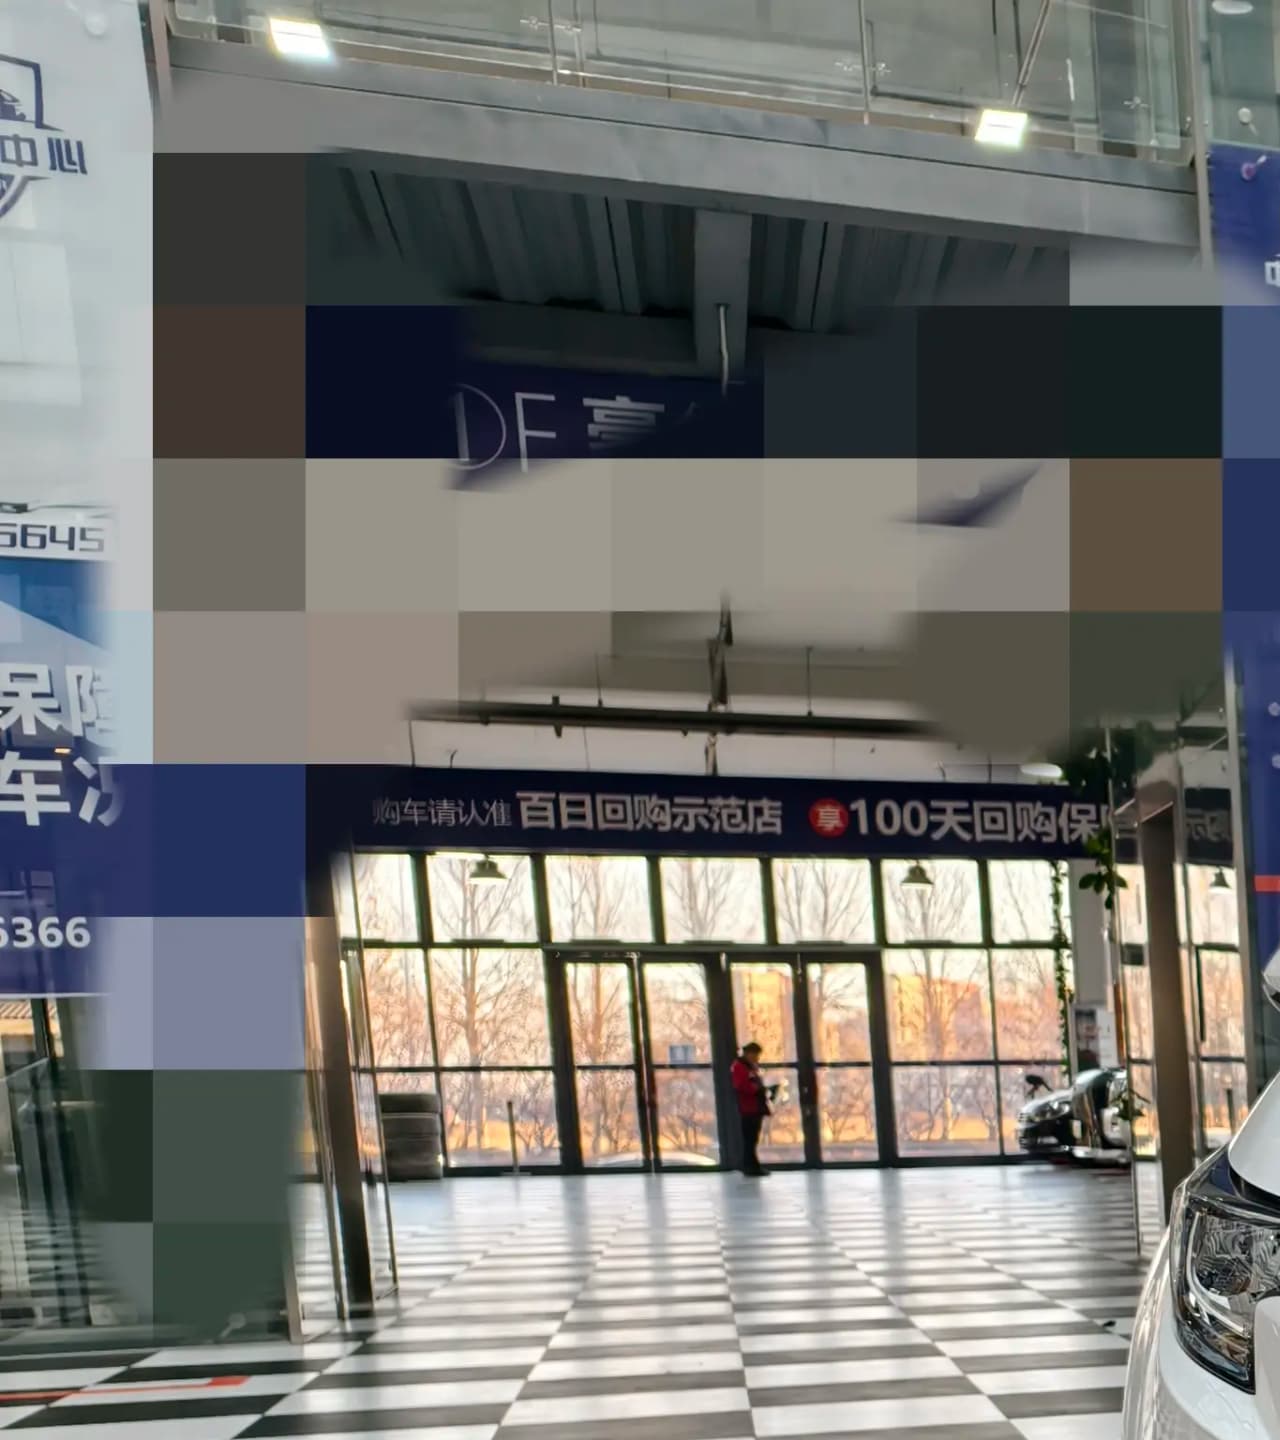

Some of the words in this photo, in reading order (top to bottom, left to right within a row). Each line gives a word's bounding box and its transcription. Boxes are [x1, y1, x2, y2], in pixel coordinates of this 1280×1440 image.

[515, 792, 783, 835] 百日回购示范店
